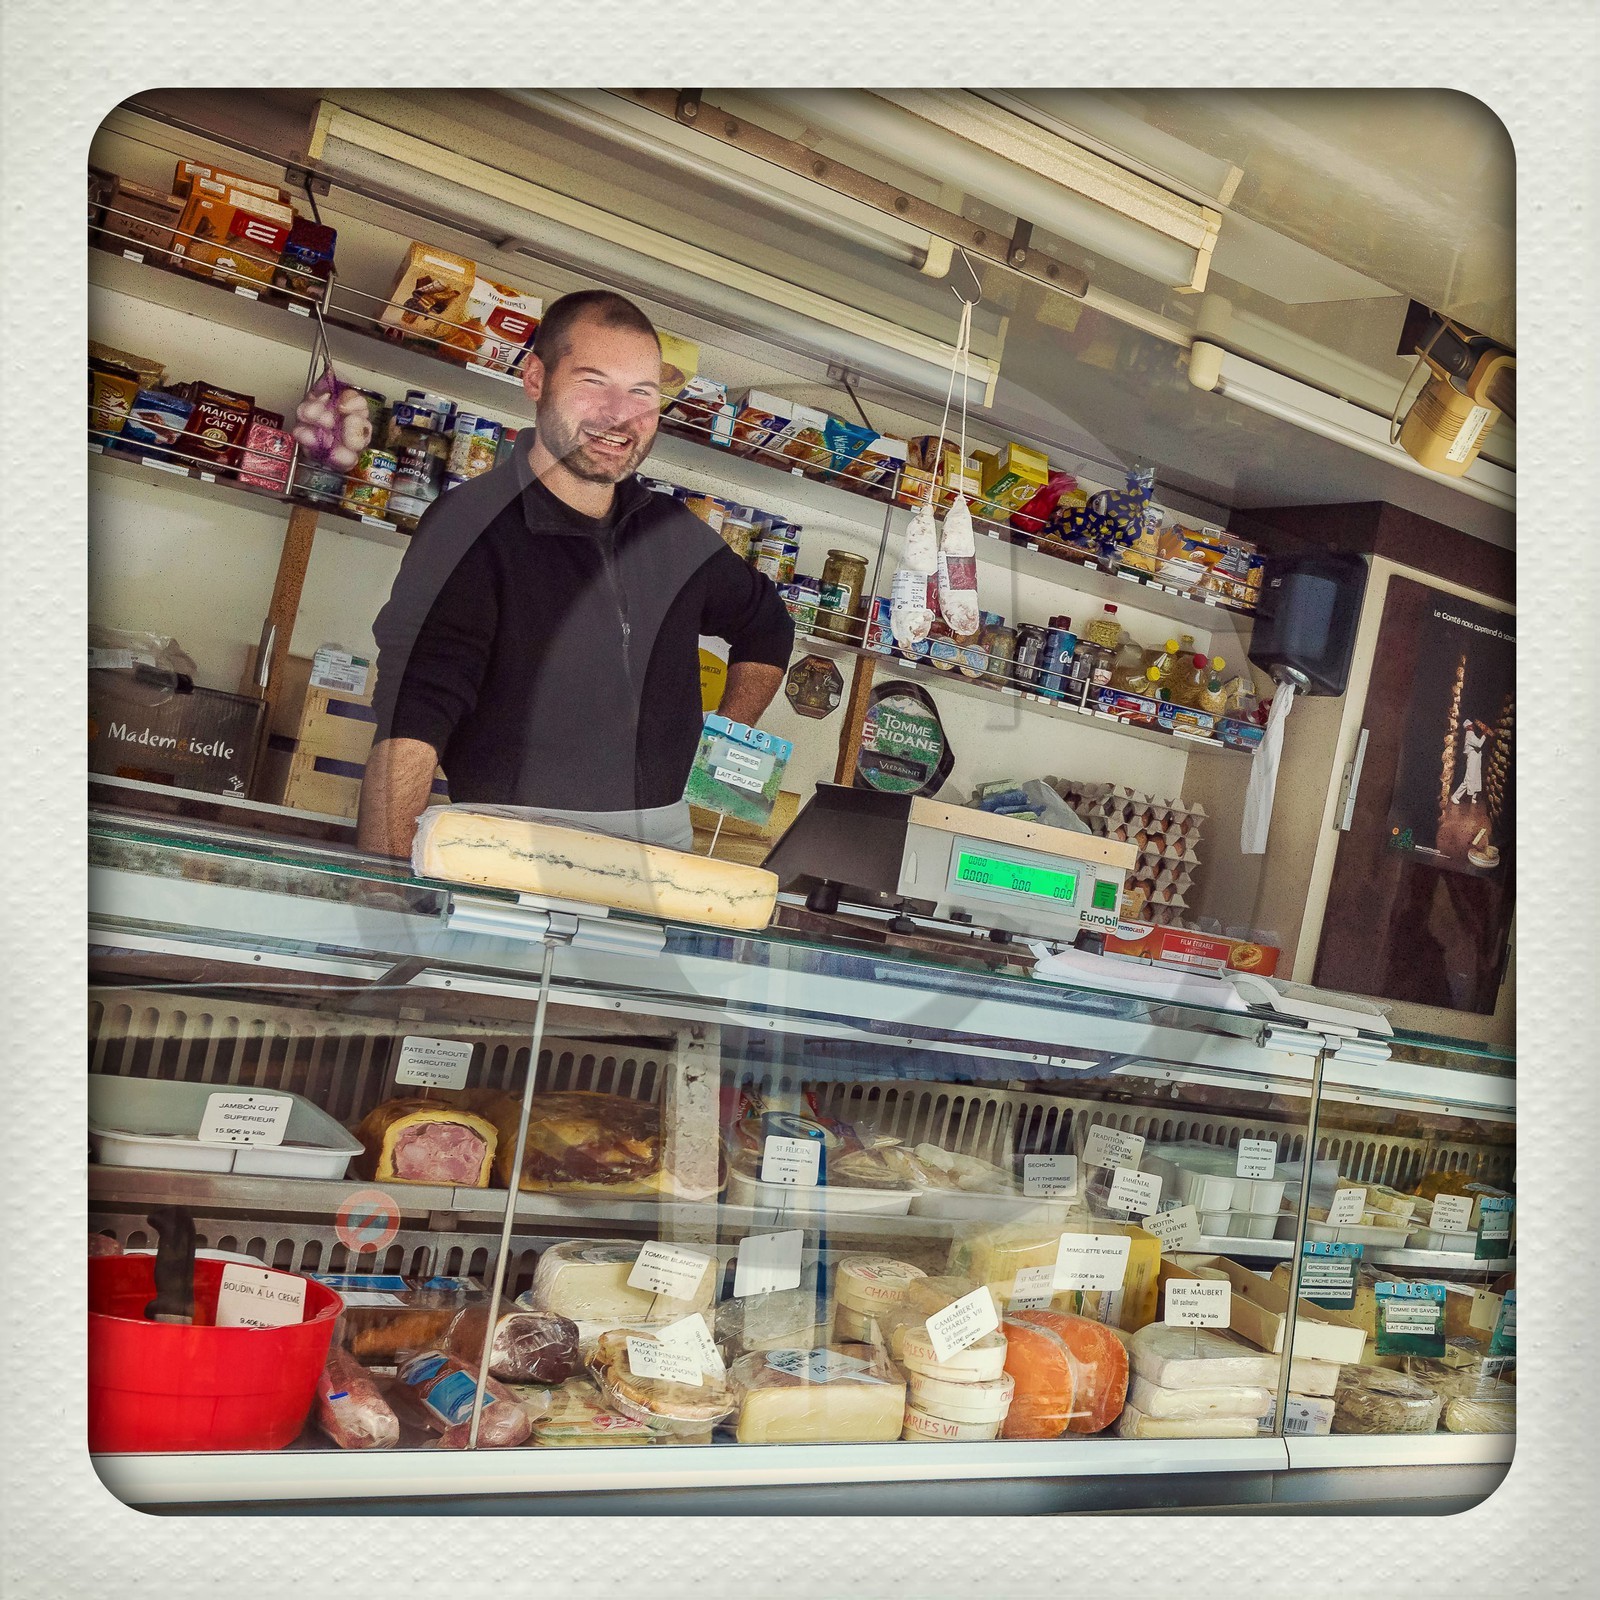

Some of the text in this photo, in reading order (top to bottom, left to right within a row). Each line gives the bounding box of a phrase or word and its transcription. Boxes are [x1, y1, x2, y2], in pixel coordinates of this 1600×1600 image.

[198, 403, 247, 426] MAISON
[252, 413, 279, 429] ISON
[1433, 609, 1442, 618] Le
[1441, 611, 1462, 625] Comté
[1460, 619, 1474, 629] nous
[1473, 624, 1498, 638] apprend
[882, 712, 933, 738] TOMME
[861, 721, 941, 754] ERIDANE
[728, 751, 760, 769] MORBIER
[716, 769, 762, 790] LAIT CRU AOP
[1079, 910, 1118, 927] Eurobil
[1117, 924, 1145, 934] romocash
[403, 1046, 424, 1054] PATE
[437, 1050, 469, 1059] CROUTE
[408, 1058, 457, 1068] CHARCUTIER
[218, 1103, 256, 1111] JAMBON
[223, 1113, 276, 1124] SUPERIEUR
[1092, 1132, 1125, 1145] TRADITION
[785, 1146, 810, 1155] FELICIEN
[1149, 1218, 1175, 1230] CROTTIN
[1165, 1222, 1188, 1233] CHEVRE
[1066, 1247, 1101, 1255] MIMOLETTE
[644, 1249, 703, 1270] TOMME BLANCHE
[223, 1281, 254, 1295] BOUDIN
[265, 1290, 274, 1299] LA
[1172, 1287, 1187, 1295] BRIE
[934, 1302, 976, 1331] CAMEMBERT
[941, 1314, 971, 1335] CHARLES
[905, 1413, 959, 1437] ARLES VII
